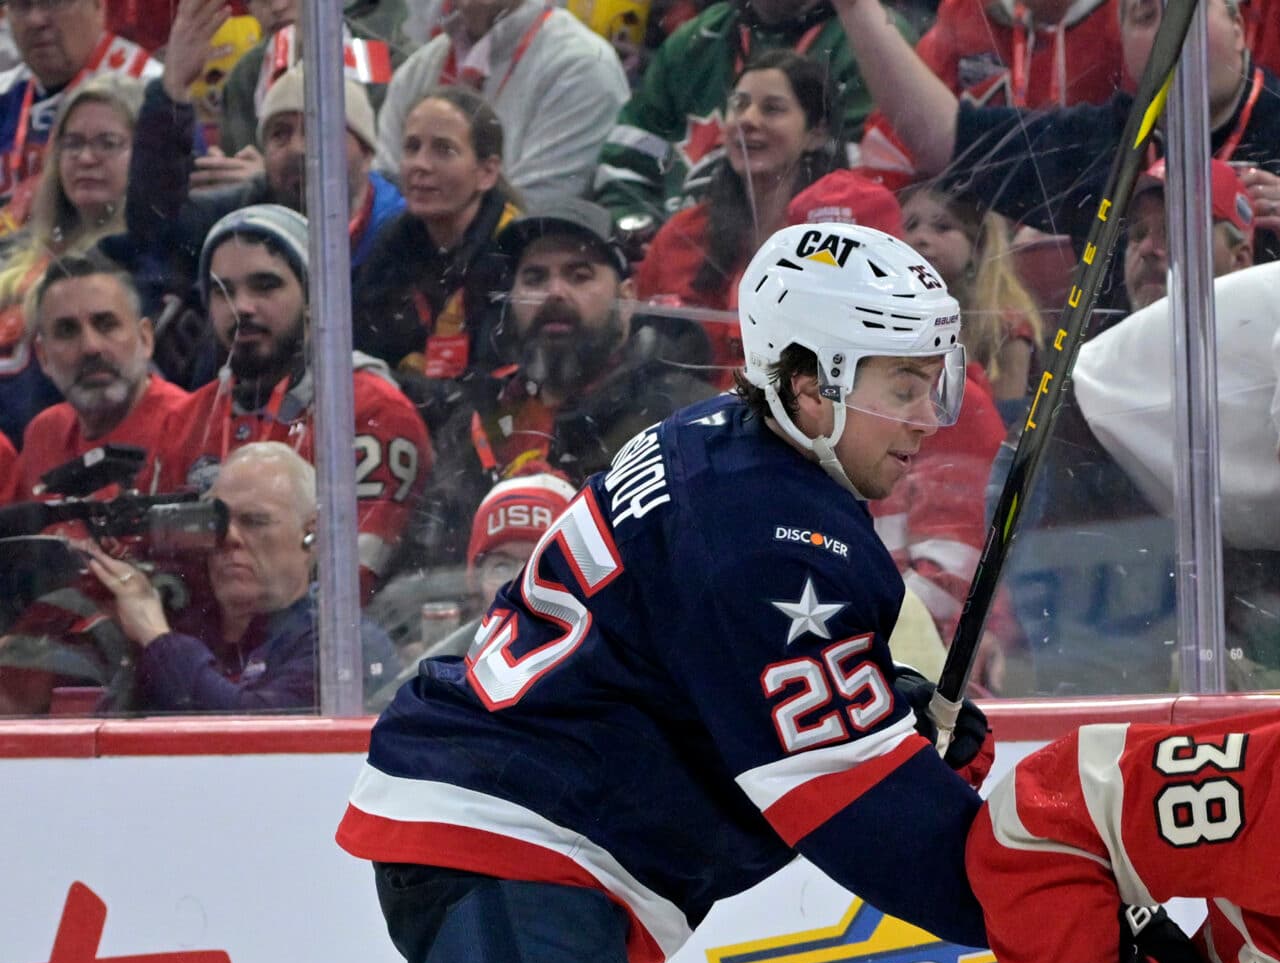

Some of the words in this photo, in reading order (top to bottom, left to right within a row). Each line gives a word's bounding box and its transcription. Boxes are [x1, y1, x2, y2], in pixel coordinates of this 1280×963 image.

[796, 230, 861, 268] CAT
[907, 265, 943, 290] 25
[353, 434, 419, 502] 29
[487, 504, 551, 536] USA
[775, 526, 849, 558] DISCOVER
[760, 632, 894, 752] 25
[1152, 733, 1250, 848] 38
